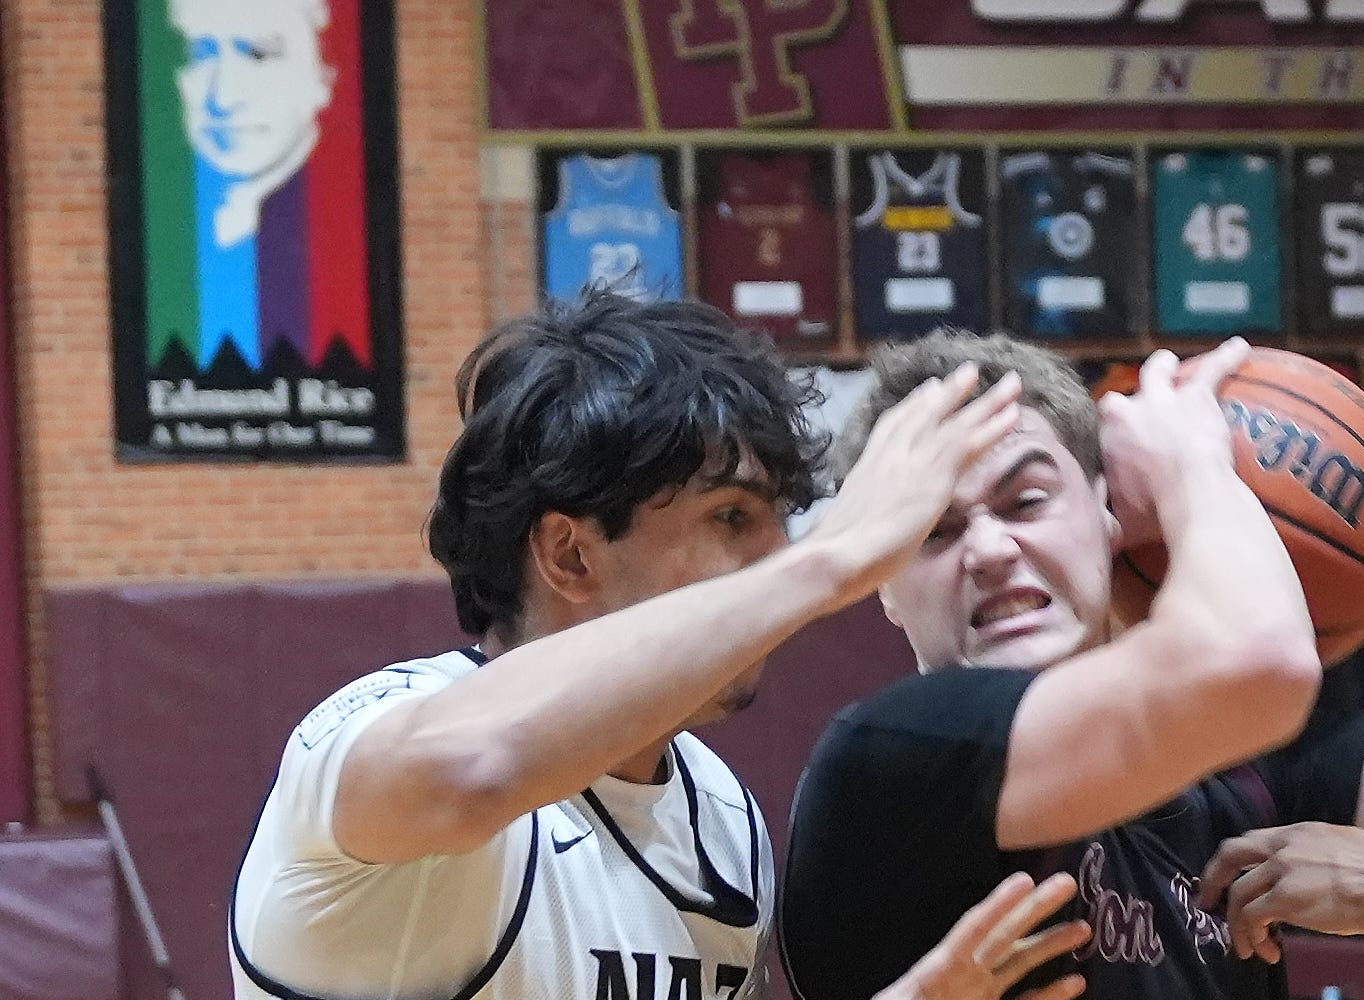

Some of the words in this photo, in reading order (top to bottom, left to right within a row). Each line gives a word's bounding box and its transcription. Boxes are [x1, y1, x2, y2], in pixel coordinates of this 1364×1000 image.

[1105, 53, 1192, 94] IN
[1183, 203, 1251, 262] 46
[298, 377, 376, 417] Rice
